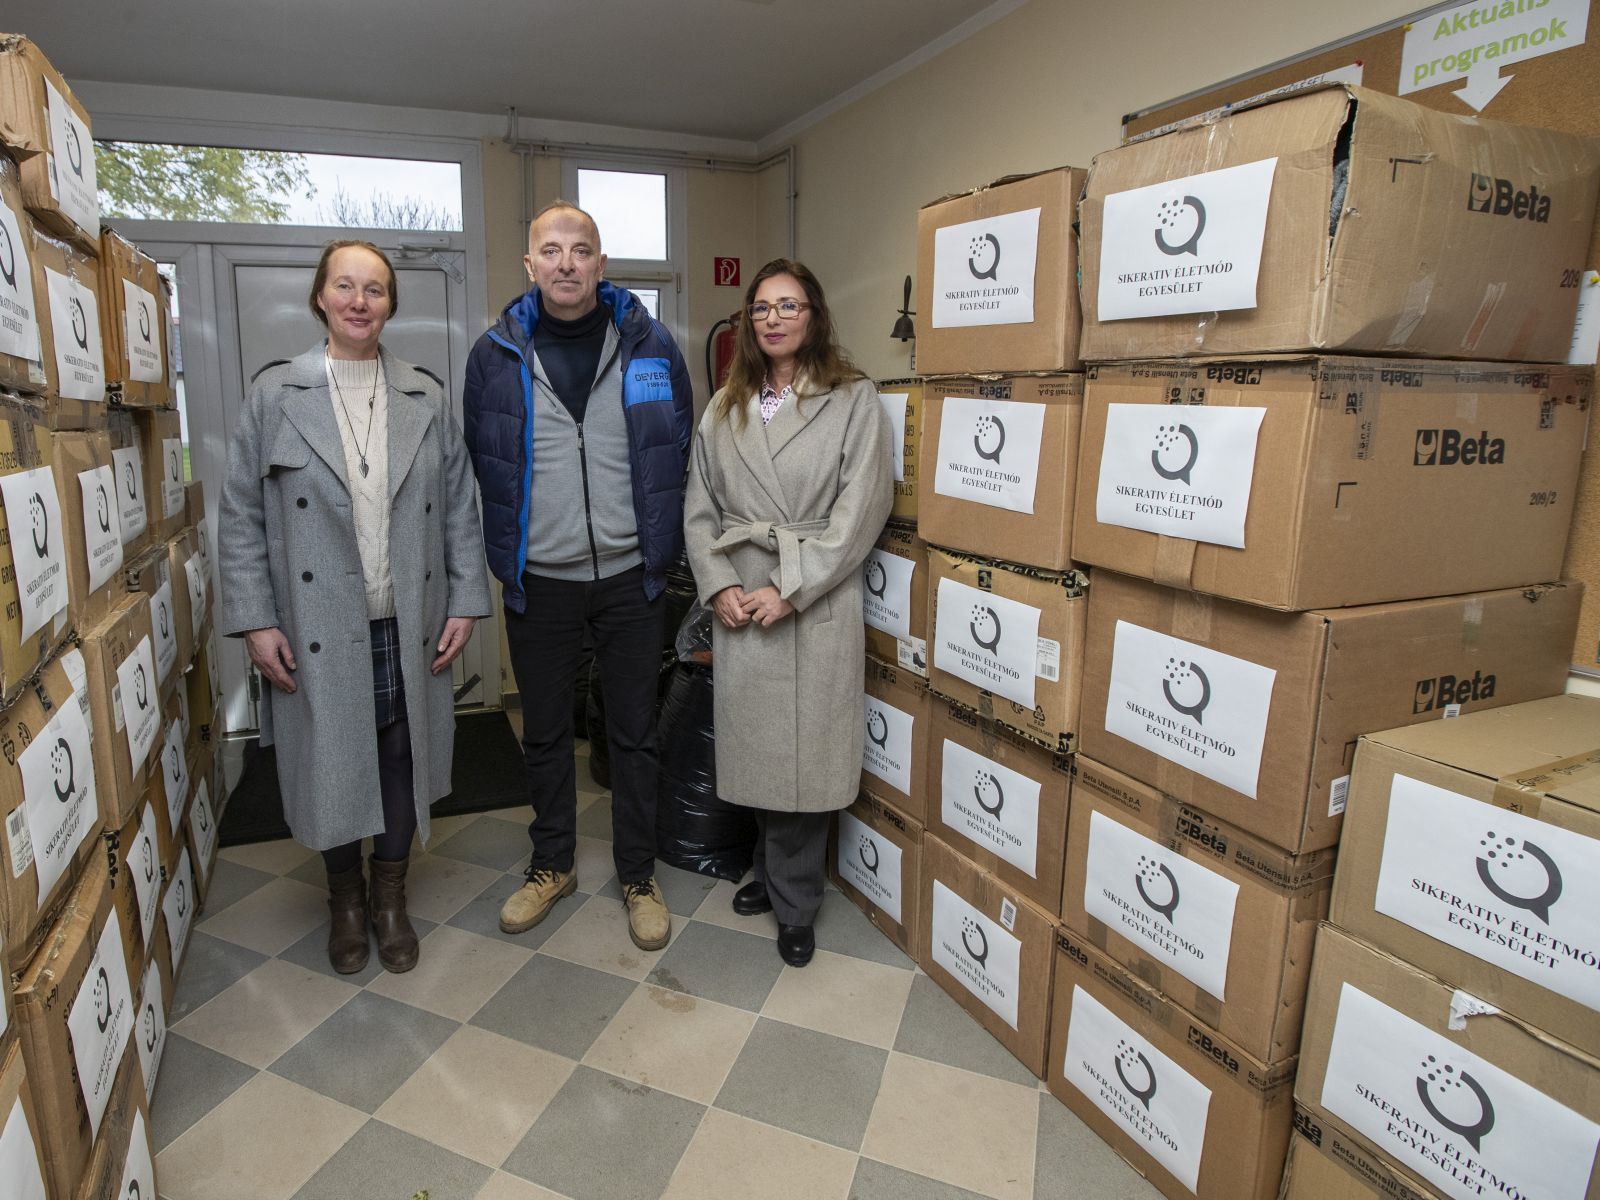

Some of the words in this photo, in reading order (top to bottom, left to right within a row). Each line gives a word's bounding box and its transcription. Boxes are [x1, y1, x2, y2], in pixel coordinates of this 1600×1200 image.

[1414, 17, 1567, 86] programok
[1493, 179, 1551, 224] Beta
[1117, 268, 1171, 285] SIKERATIV
[1174, 260, 1233, 281] ÉLETMÓD
[1138, 281, 1203, 298] EGYESÜLET
[945, 289, 981, 301] SIKERATIV
[983, 285, 1020, 297] ÉLETMÓD
[959, 300, 1001, 311] EGYESÜLET
[635, 371, 672, 382] DEVERG
[979, 386, 1003, 398] Beta
[1206, 367, 1248, 385] Beta
[1439, 429, 1505, 466] Beta
[948, 462, 984, 478] SIKERATIV
[984, 466, 1021, 484] ÉLETMÓD
[961, 477, 1003, 493] EGYESÜLET
[1115, 484, 1167, 503] SIKERATIV
[1168, 489, 1223, 509] ÉLETMÓD
[1135, 502, 1196, 521] EGYESÜLET
[1529, 491, 1557, 506] 209/2
[947, 641, 982, 662] SIKERATIV
[984, 653, 1020, 680] ÉLETMÓD
[961, 658, 1002, 683] EGYESÜLET
[1435, 670, 1496, 708] Beta
[957, 708, 977, 727] Beta
[1125, 700, 1179, 730] SIKERATIV
[1181, 724, 1236, 757] ÉLETMÓD
[1146, 723, 1208, 759] EGYESÜLET
[953, 800, 988, 826] SIKERATIV
[986, 818, 1022, 848] ÉLETMÓD
[966, 819, 1006, 848] EGYESÜLET
[1188, 820, 1227, 855] Beta
[1235, 850, 1254, 867] Beta
[1256, 859, 1291, 884] Utensili
[1411, 878, 1506, 926] SIKERATIV
[1102, 887, 1152, 925] SIKERATIV
[1152, 919, 1205, 961] ÉLETMÓD
[1121, 913, 1179, 957] EGYESÜLET
[1447, 911, 1560, 969] EGYESÜLET
[942, 942, 976, 970] SIKERATIV
[1061, 937, 1089, 966] Beta
[954, 961, 991, 997] EGYESÜLET
[1200, 1034, 1240, 1073] Beta
[1082, 1060, 1129, 1106] SIKERATIV
[1130, 1105, 1179, 1152] ÉLETMÓD
[1099, 1089, 1154, 1143] EGYESÜLET
[1295, 1109, 1323, 1138] eta
[1355, 1083, 1441, 1146] SIKERATIV
[1444, 1142, 1531, 1200] ÉLETMÓ
[1386, 1121, 1487, 1196] EGYESÜLET
[1332, 1140, 1356, 1161] Beta
[1357, 1157, 1398, 1192] Utensili
